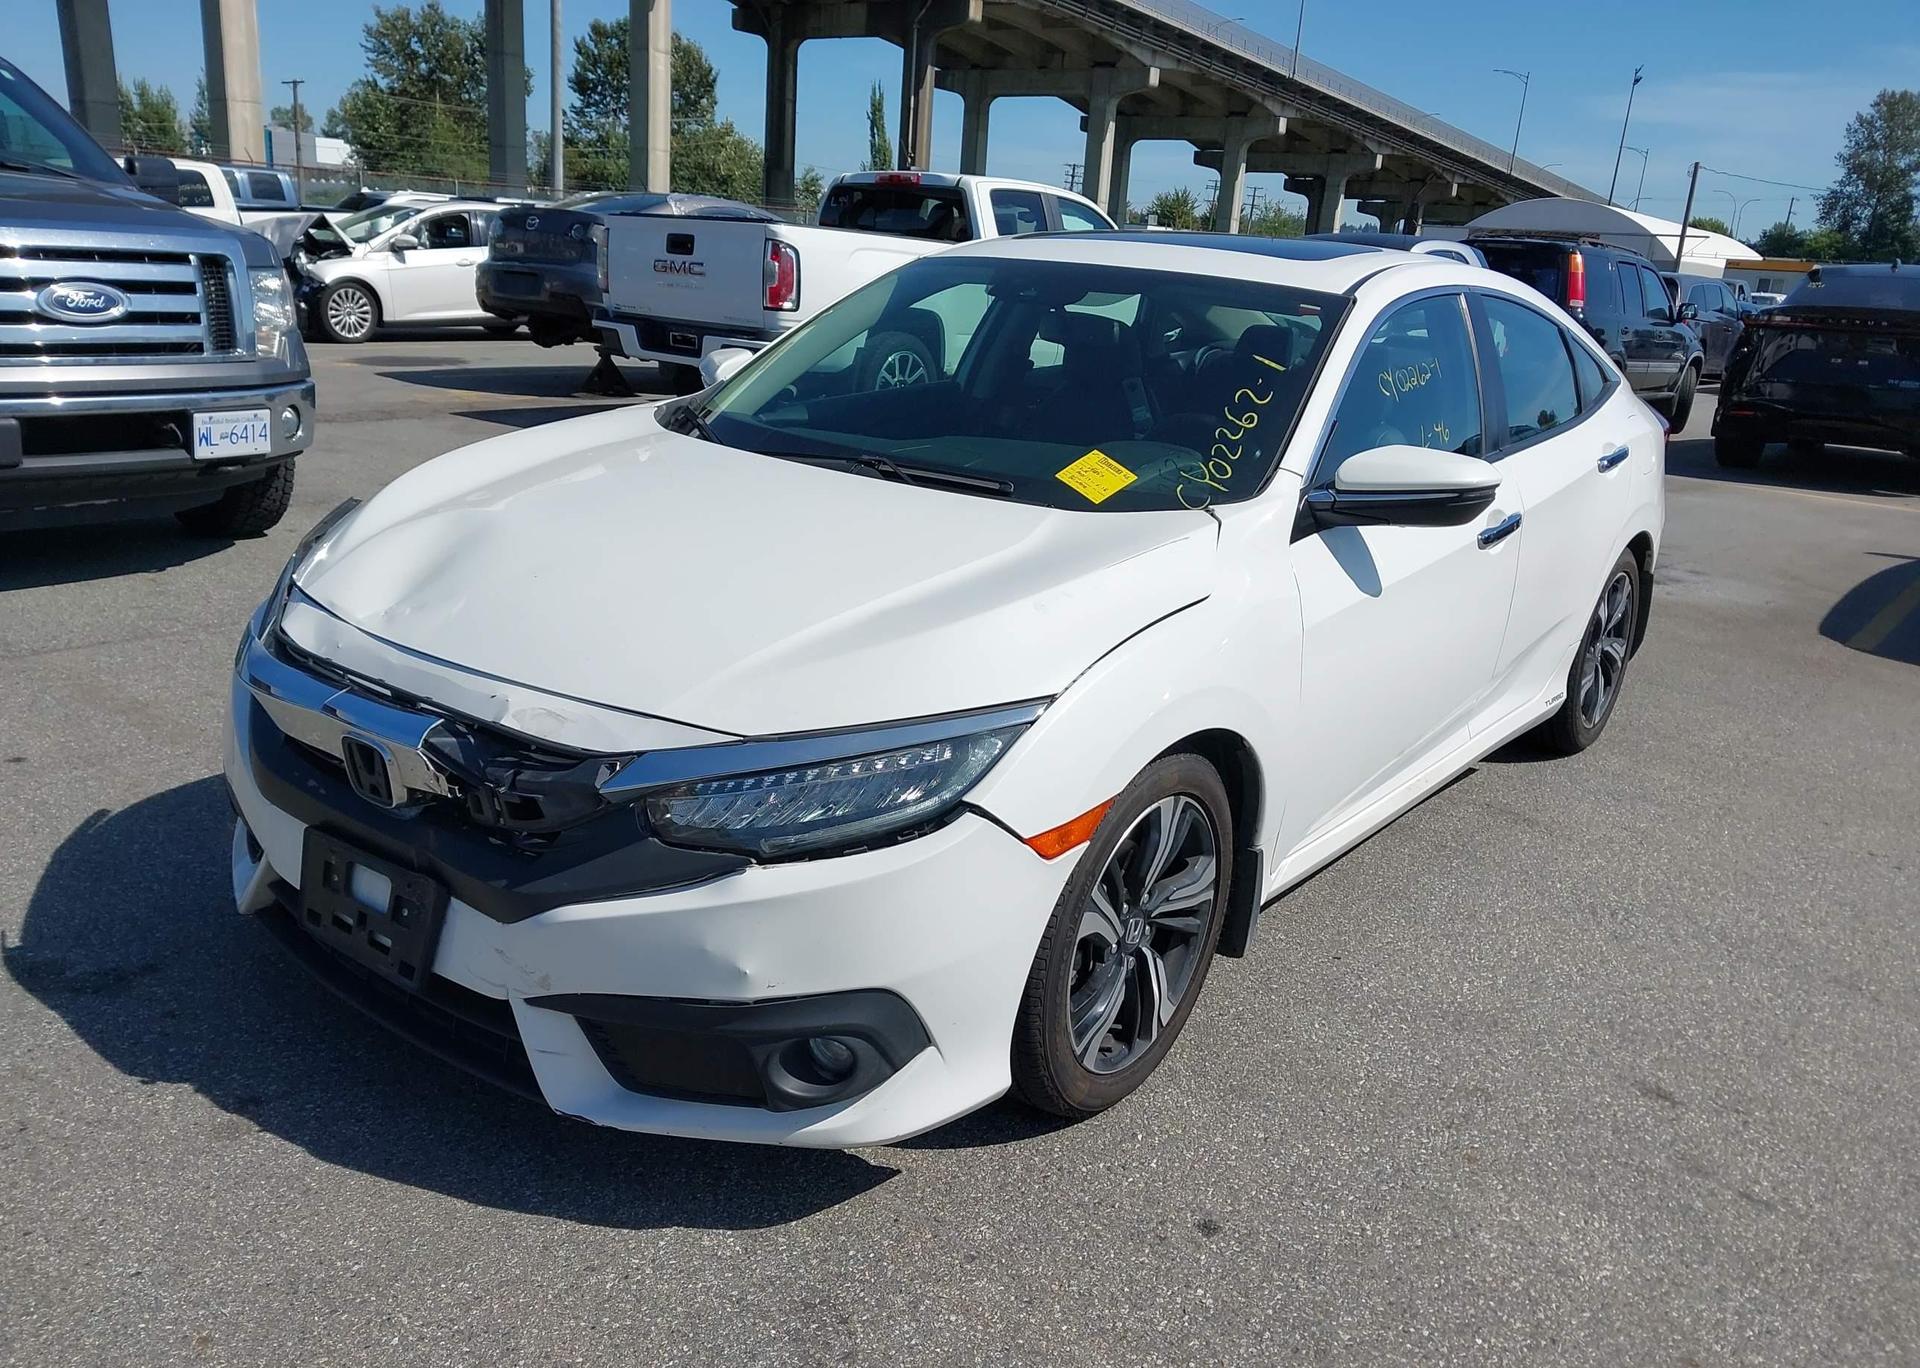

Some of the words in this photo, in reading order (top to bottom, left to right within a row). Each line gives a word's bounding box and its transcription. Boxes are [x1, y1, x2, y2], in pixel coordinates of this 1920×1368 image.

[653, 259, 706, 277] GMC
[65, 290, 105, 308] Ford
[1378, 357, 1442, 402] CY02262-1
[198, 426, 219, 447] WL
[229, 422, 268, 445] 6414
[1176, 353, 1287, 511] CY02262-1
[1544, 691, 1564, 708] TURBO
